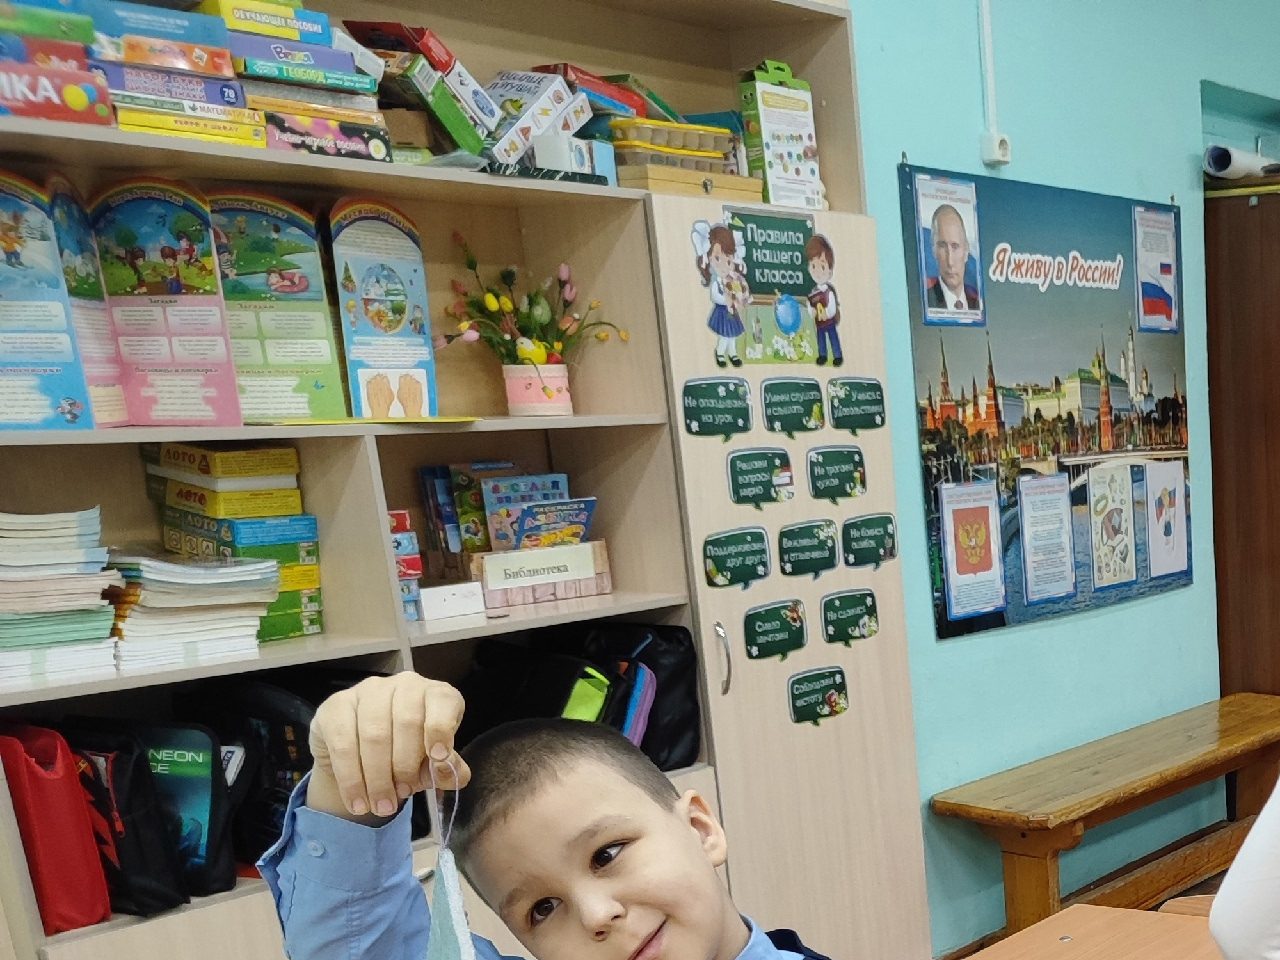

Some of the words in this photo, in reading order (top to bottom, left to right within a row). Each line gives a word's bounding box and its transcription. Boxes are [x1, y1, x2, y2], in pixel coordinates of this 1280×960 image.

[746, 223, 804, 247] Правила
[752, 248, 802, 266] нашего
[755, 268, 804, 285] класса
[994, 248, 1008, 276] Я
[1010, 257, 1053, 288] живу
[1056, 261, 1064, 281] в
[1069, 256, 1121, 284] России!
[504, 563, 569, 580] Библиотека
[148, 749, 203, 763] NEON
